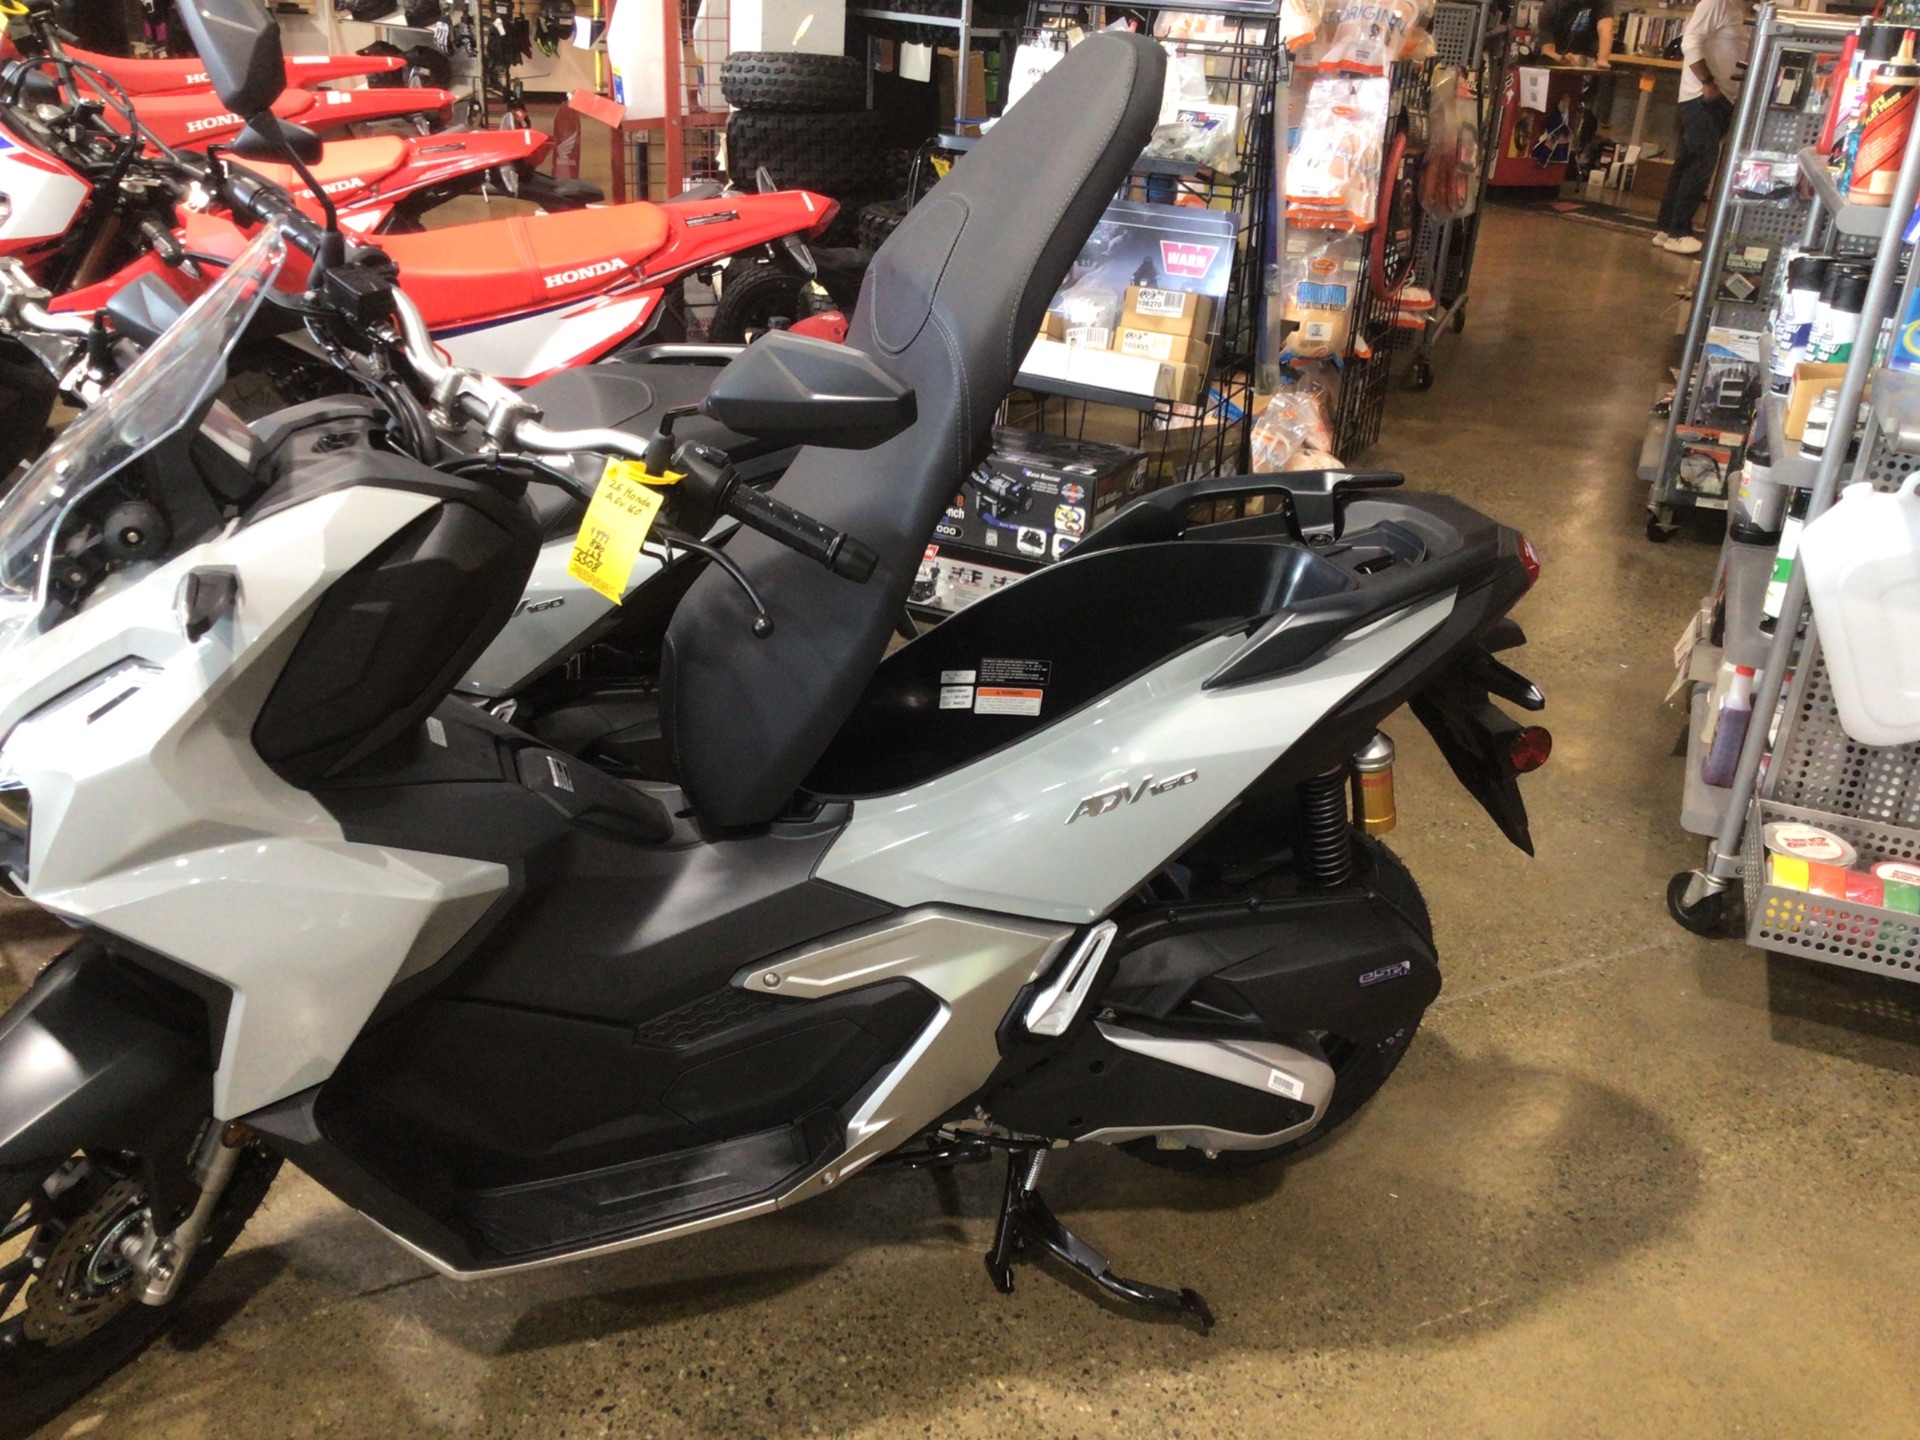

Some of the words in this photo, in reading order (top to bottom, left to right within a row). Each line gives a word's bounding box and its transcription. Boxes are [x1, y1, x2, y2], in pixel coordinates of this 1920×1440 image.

[1167, 251, 1207, 269] WARN
[543, 257, 629, 289] HONDA
[608, 479, 624, 492] 26
[623, 487, 651, 509] Honda
[574, 552, 603, 573] 5508
